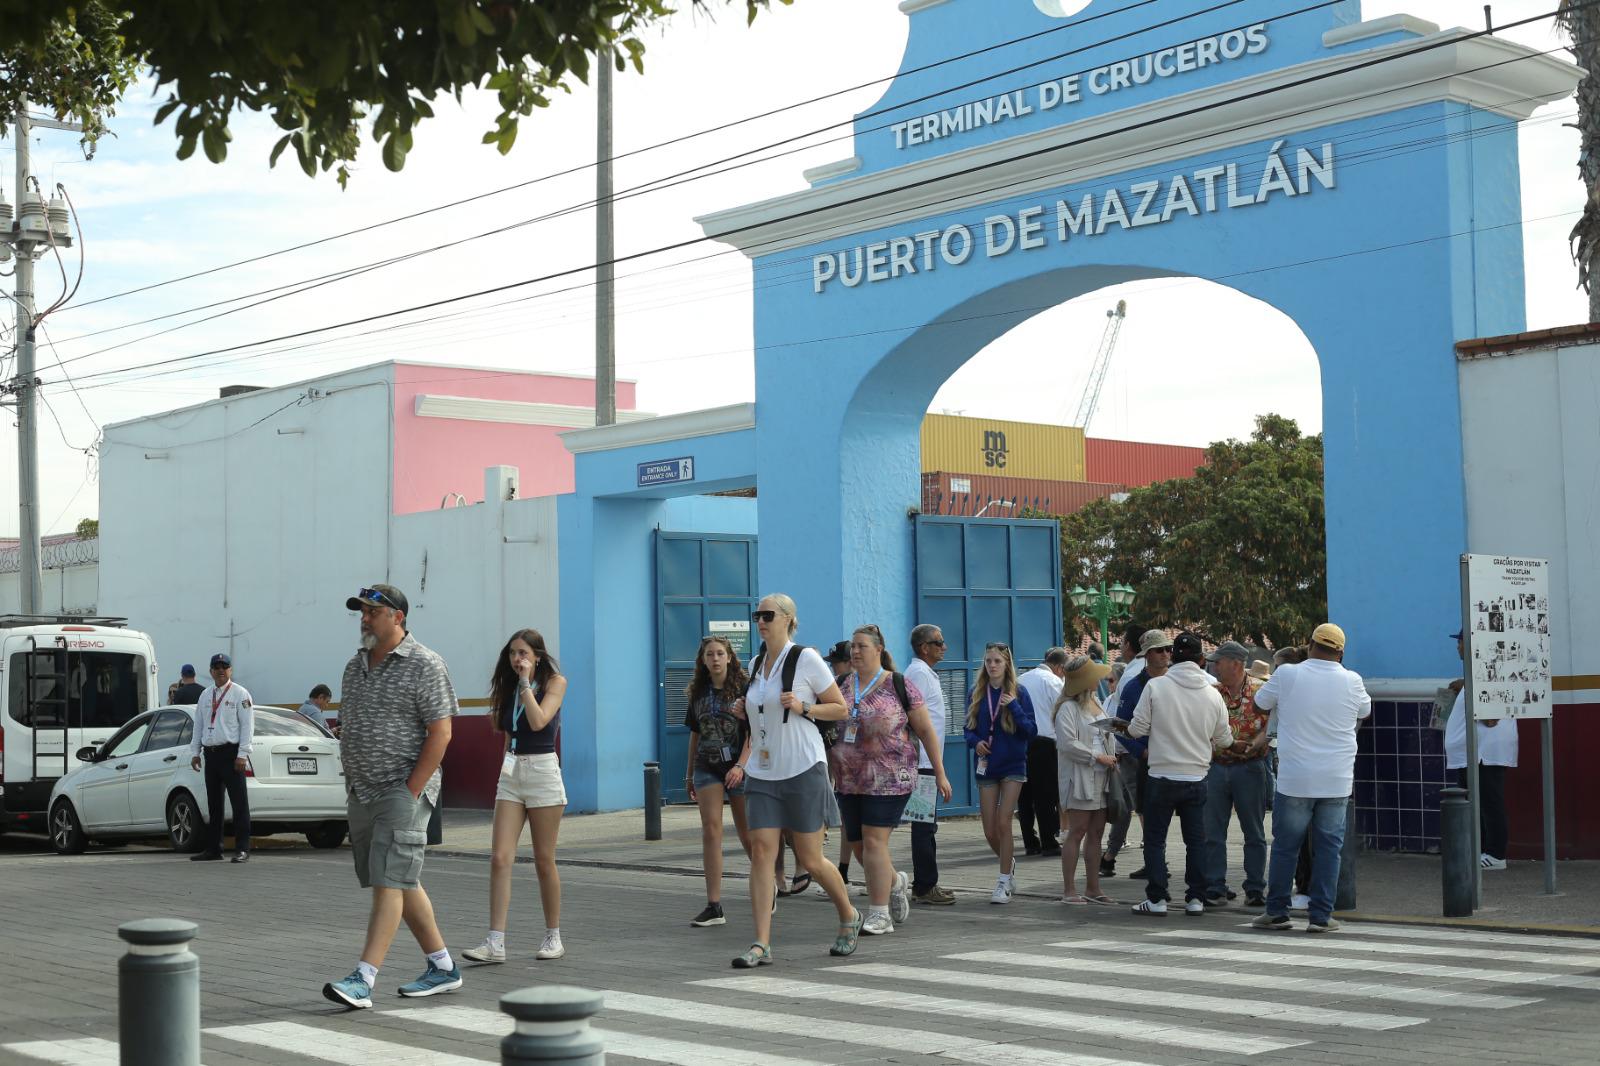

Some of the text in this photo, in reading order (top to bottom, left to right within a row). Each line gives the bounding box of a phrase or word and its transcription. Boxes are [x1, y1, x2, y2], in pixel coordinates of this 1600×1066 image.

[890, 22, 1270, 150] TERMINAL DE CRUCEROS
[813, 139, 1336, 294] PUERTO DE MAZATLÁN
[642, 472, 664, 481] ENTRANCE
[646, 465, 672, 474] ENTRADA
